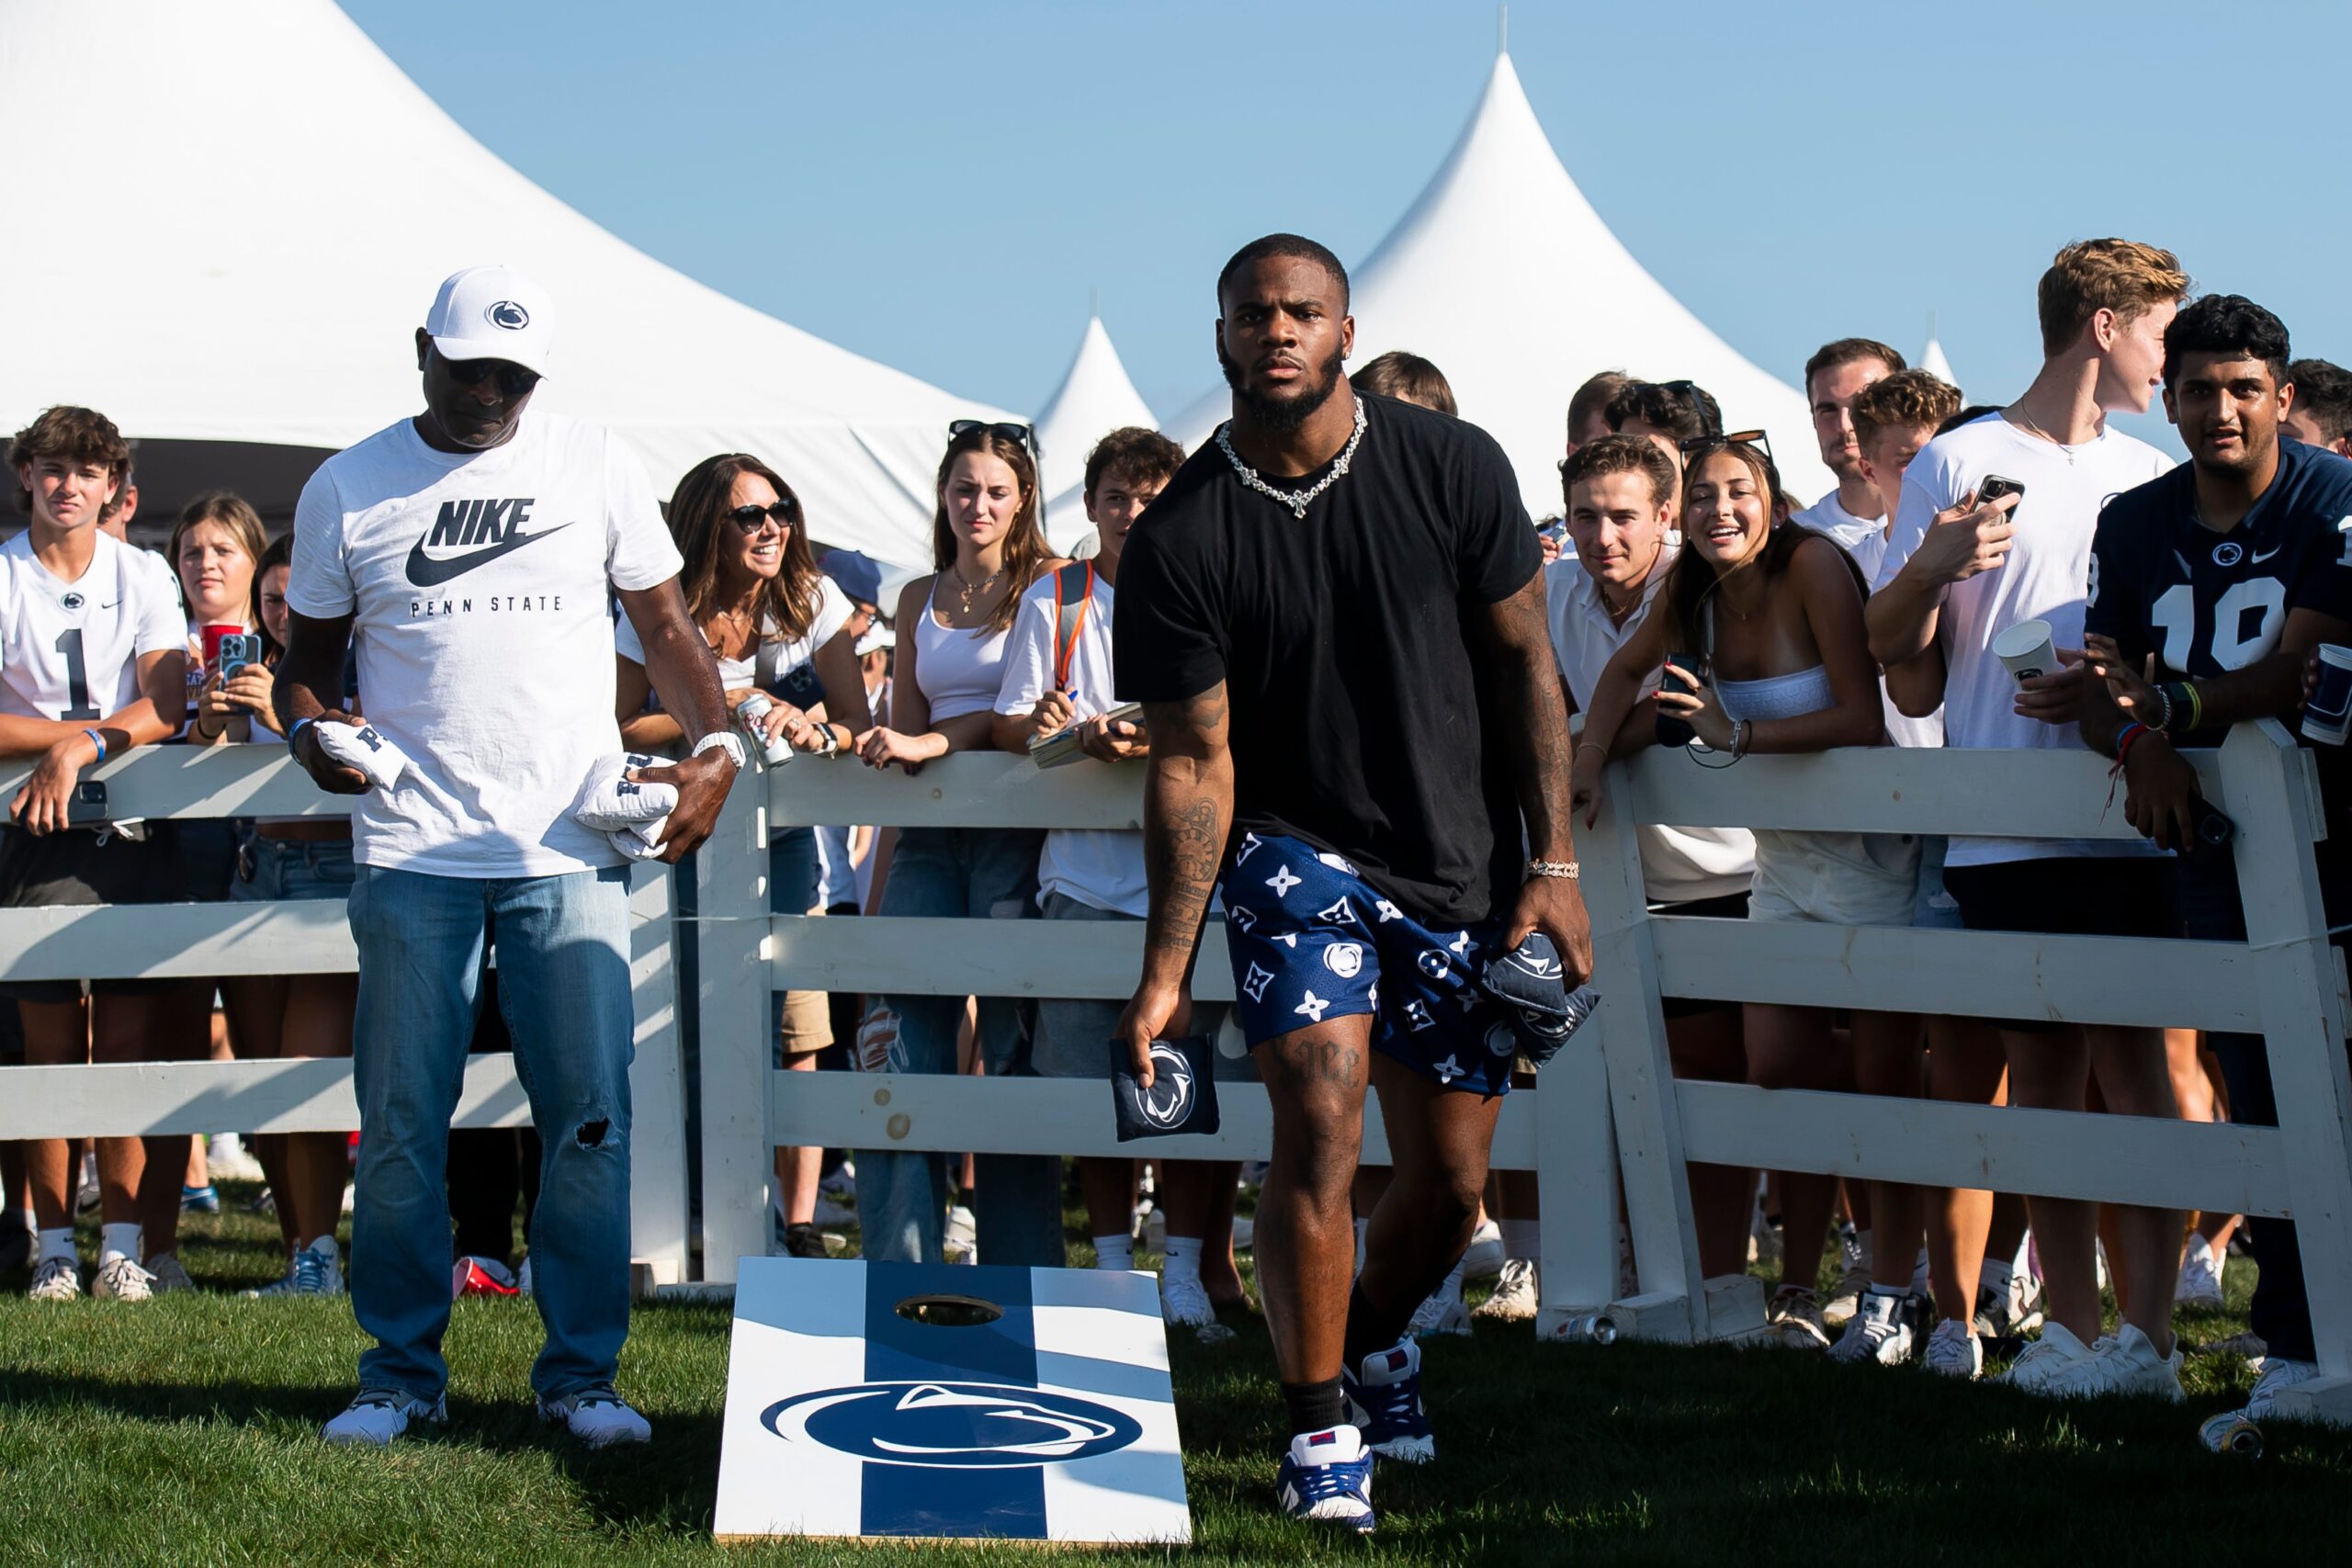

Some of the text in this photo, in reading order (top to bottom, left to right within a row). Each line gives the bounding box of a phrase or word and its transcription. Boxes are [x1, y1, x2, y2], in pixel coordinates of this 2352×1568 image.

[427, 499, 536, 547] NIKE
[412, 597, 561, 617] PENN STATE
[55, 628, 101, 720] 1
